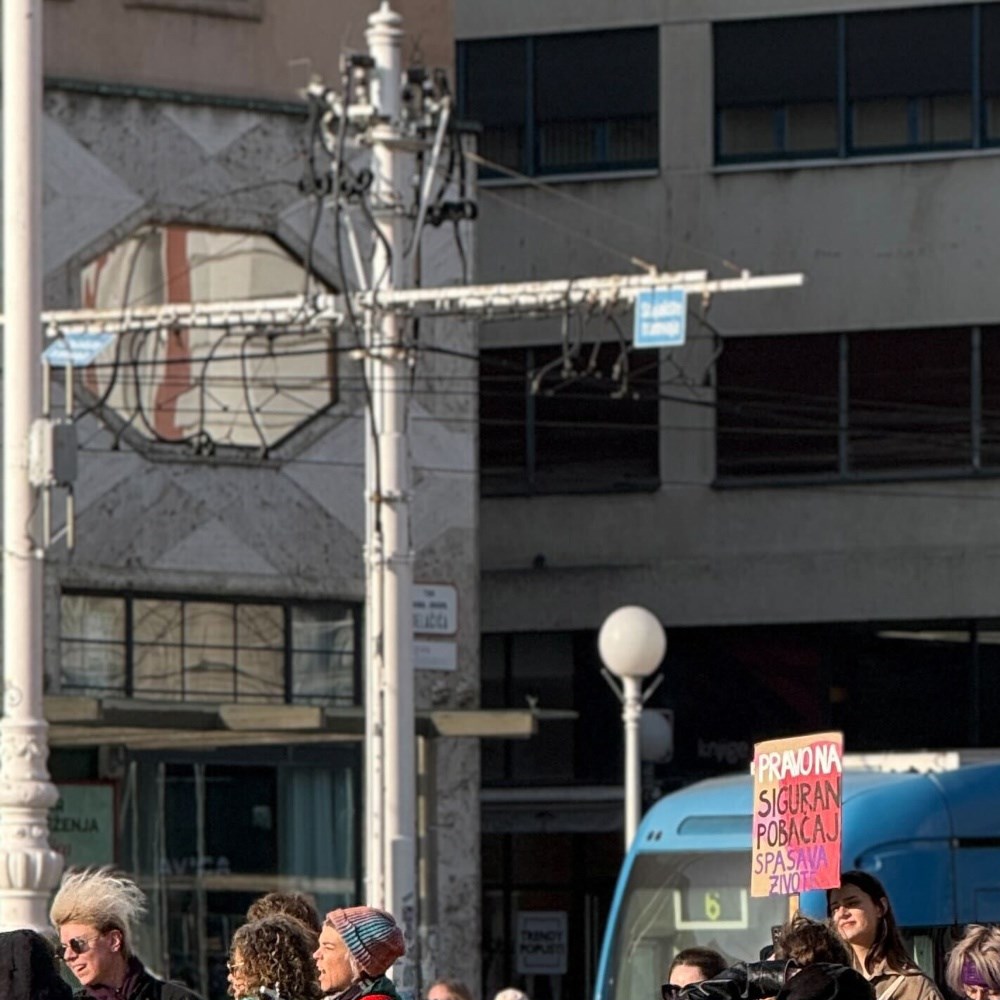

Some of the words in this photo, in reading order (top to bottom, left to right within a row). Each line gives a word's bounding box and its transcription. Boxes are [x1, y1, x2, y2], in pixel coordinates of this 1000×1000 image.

[758, 745, 813, 784] PRAVO
[814, 743, 843, 775] NA
[758, 776, 842, 818] SIGURAN
[754, 845, 829, 875] SPASAVA
[704, 888, 721, 921] 6
